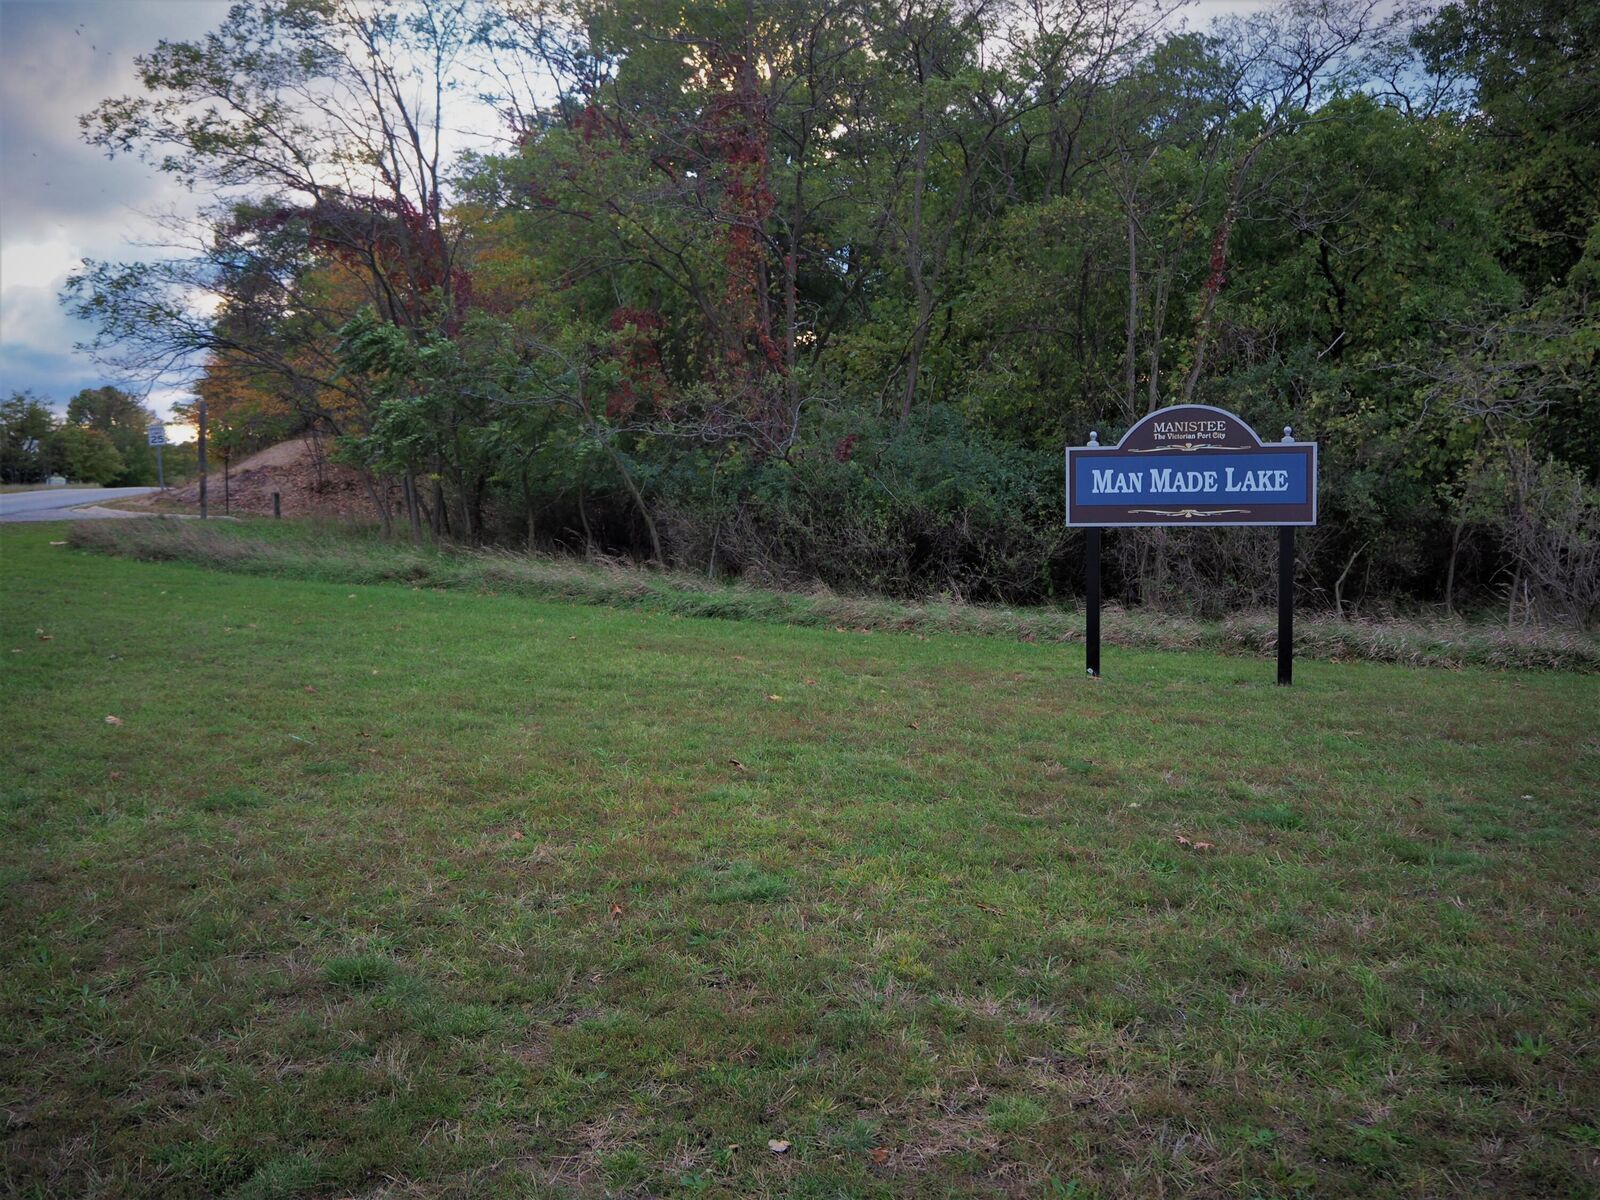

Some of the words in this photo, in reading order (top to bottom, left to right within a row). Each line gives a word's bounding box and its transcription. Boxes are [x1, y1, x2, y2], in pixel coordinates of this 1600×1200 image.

[1153, 421, 1226, 432] MANISTEE
[151, 435, 164, 444] 25
[1167, 432, 1196, 440] Victorian
[1212, 431, 1226, 440] City
[1092, 469, 1143, 494] MAN
[1150, 468, 1218, 493] MADE
[1225, 467, 1289, 492] LAKE
